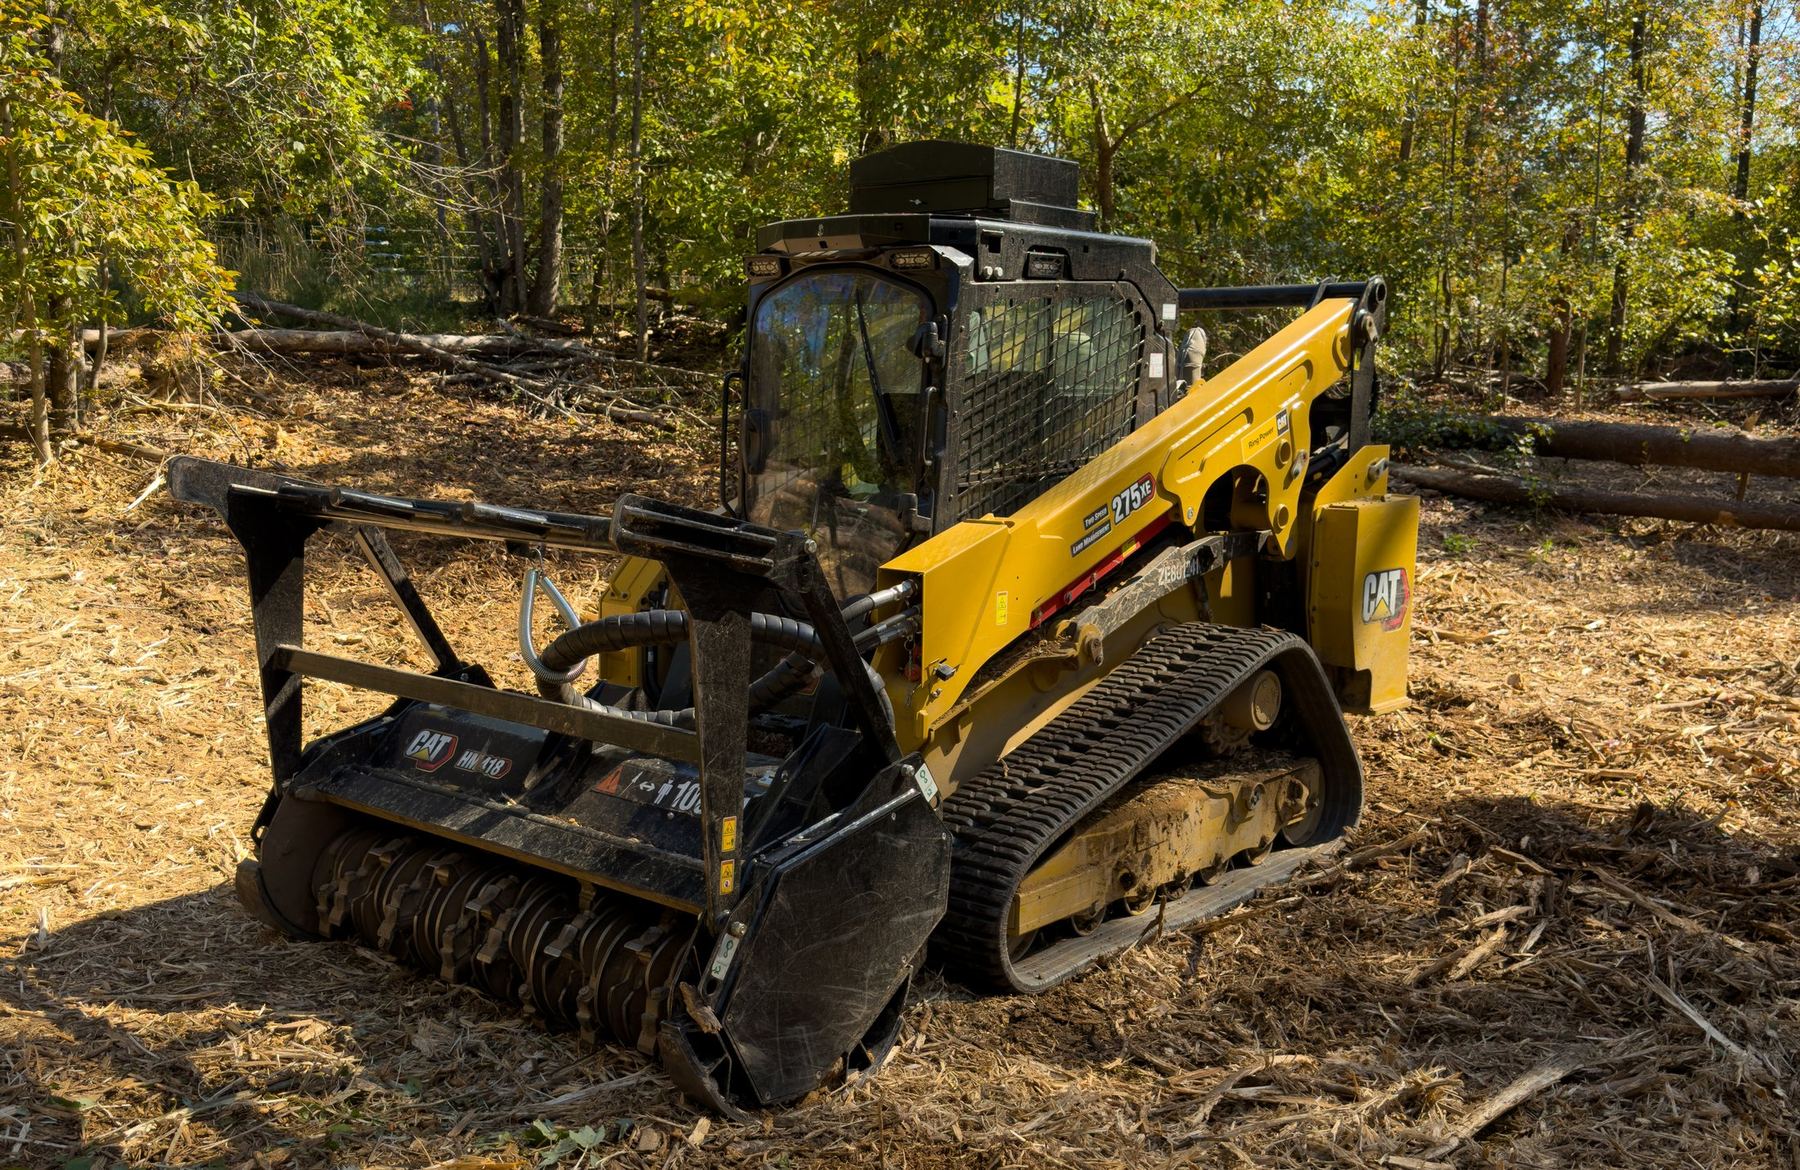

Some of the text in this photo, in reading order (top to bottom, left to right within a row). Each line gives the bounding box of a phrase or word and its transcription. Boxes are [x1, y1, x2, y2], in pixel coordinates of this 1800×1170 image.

[1362, 569, 1401, 622] CAT
[406, 730, 453, 762] CAT
[672, 780, 702, 814] 10
